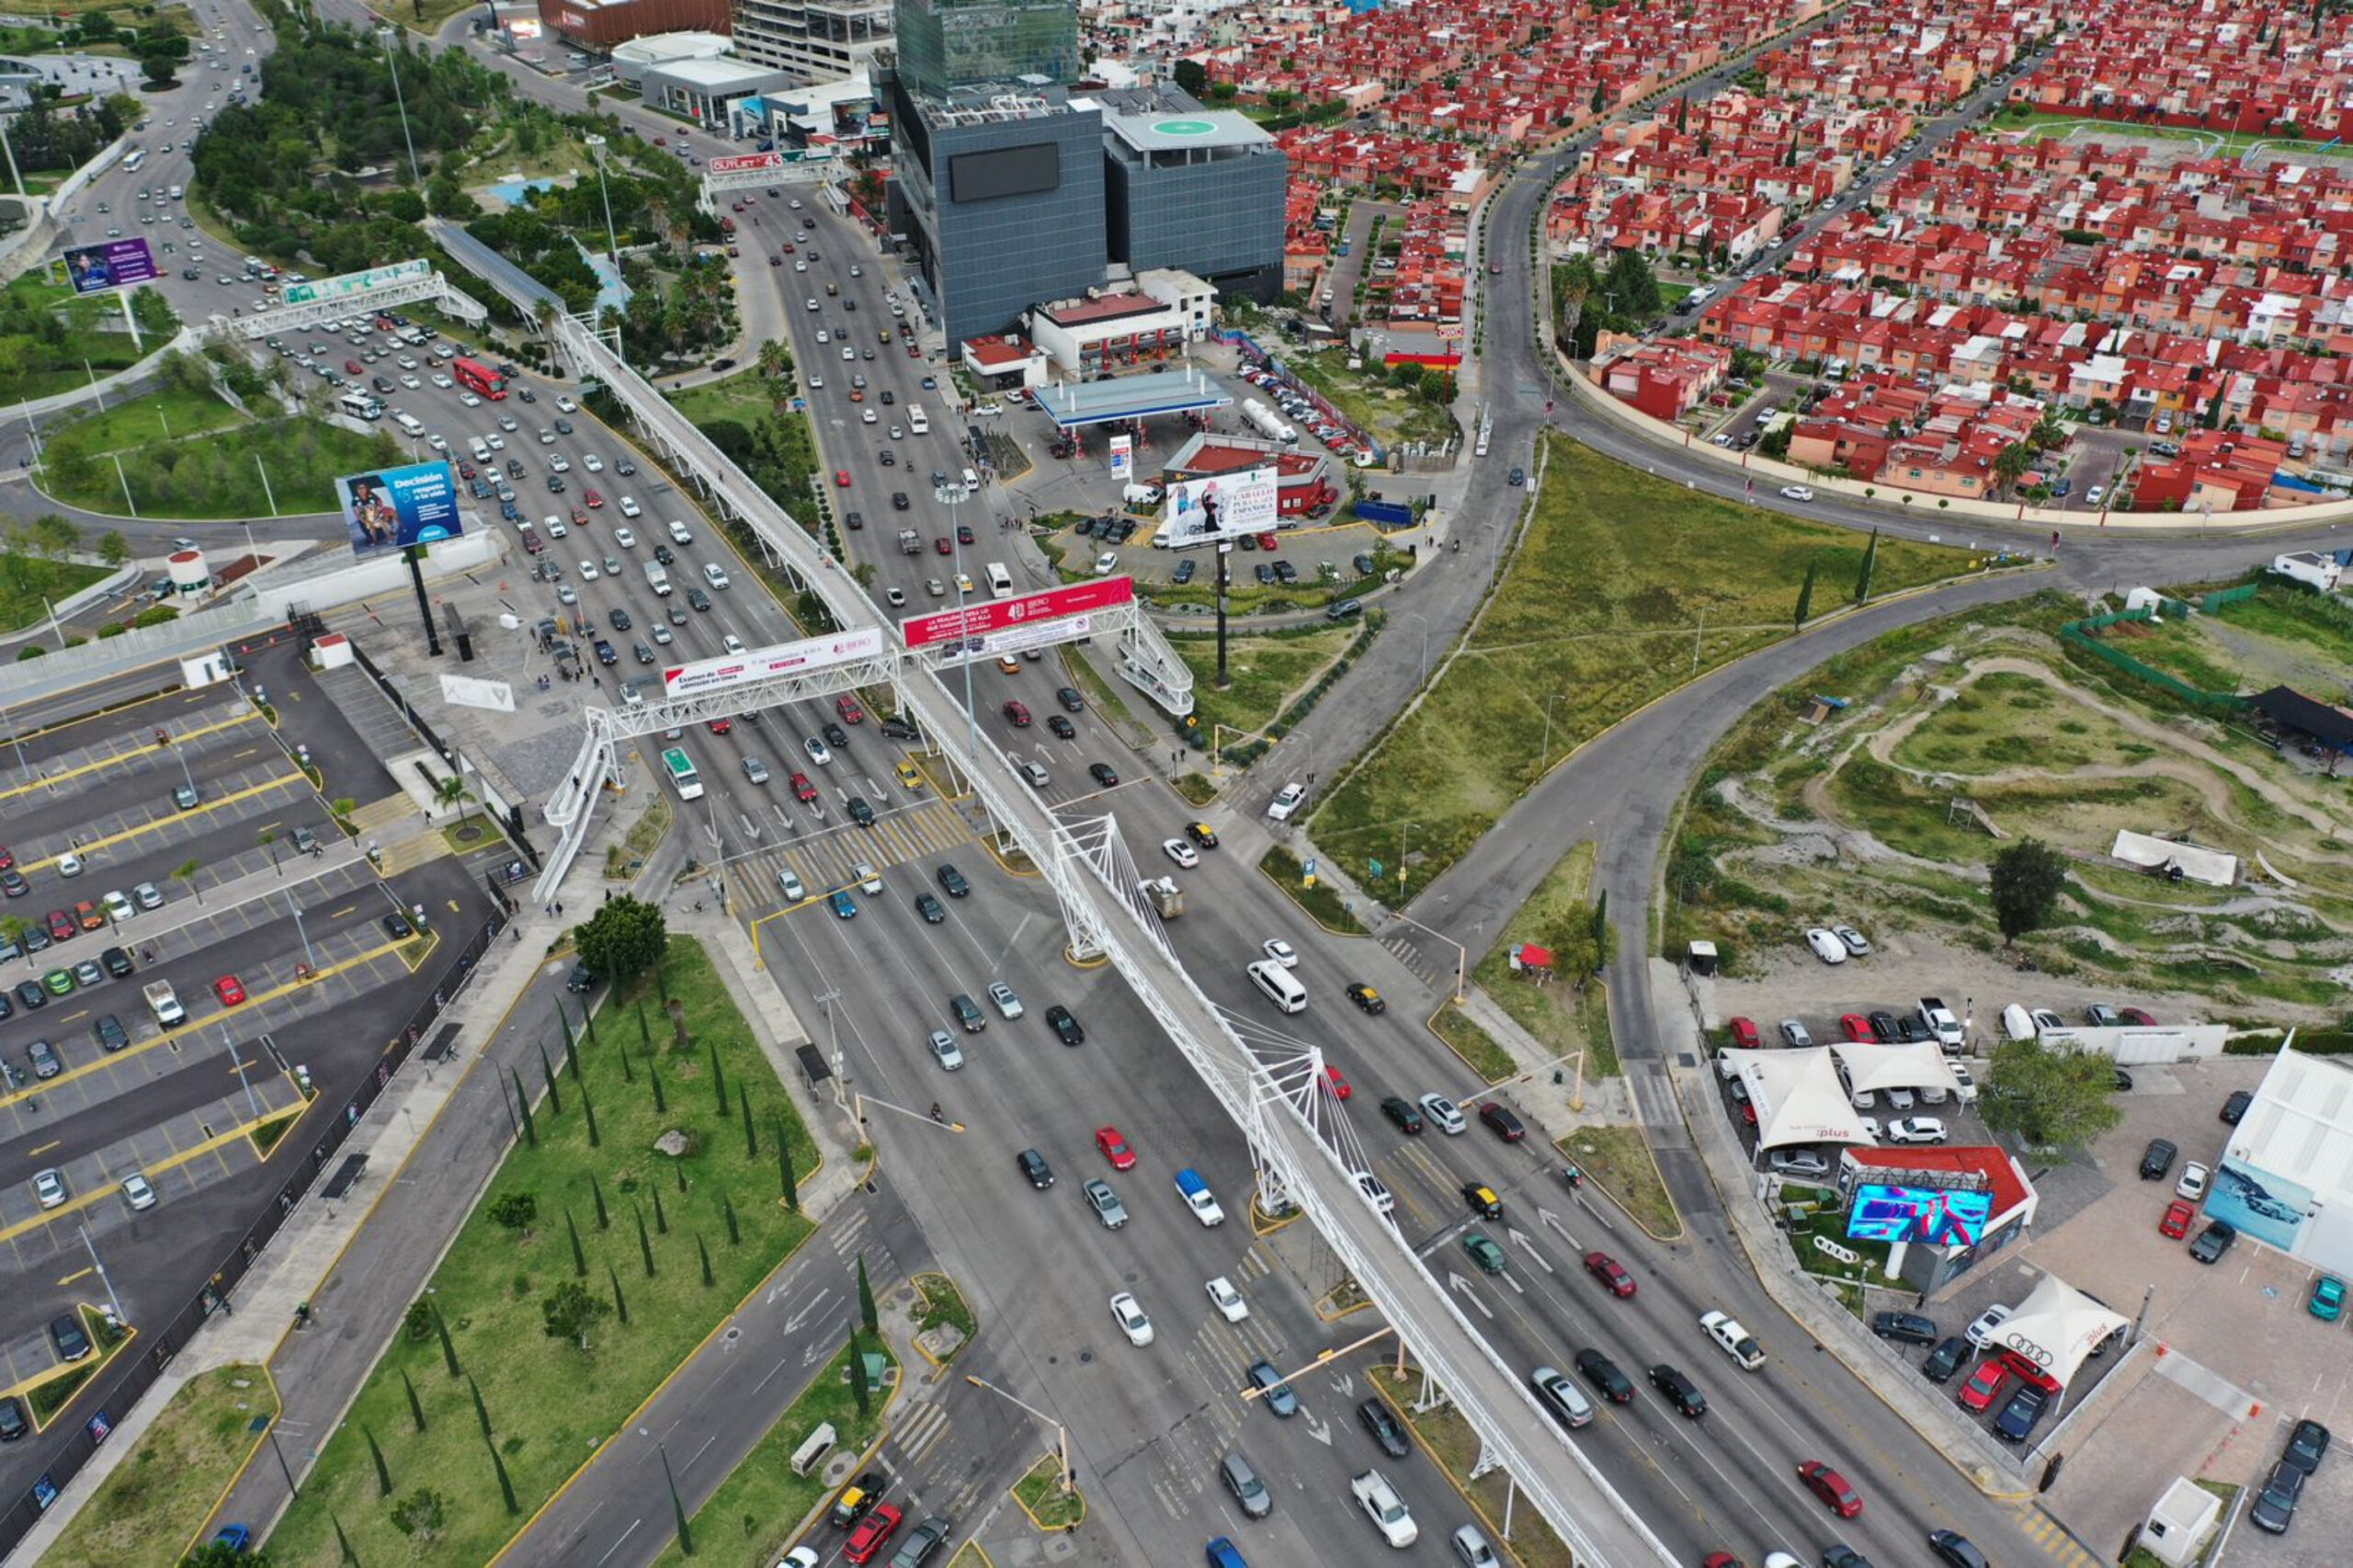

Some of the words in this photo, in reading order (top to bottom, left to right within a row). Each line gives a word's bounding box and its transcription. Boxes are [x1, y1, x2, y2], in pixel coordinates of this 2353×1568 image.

[714, 159, 754, 170] OUTLET
[393, 472, 444, 489] Decisión
[1233, 488, 1273, 501] CABALLO
[678, 673, 706, 683] Examen
